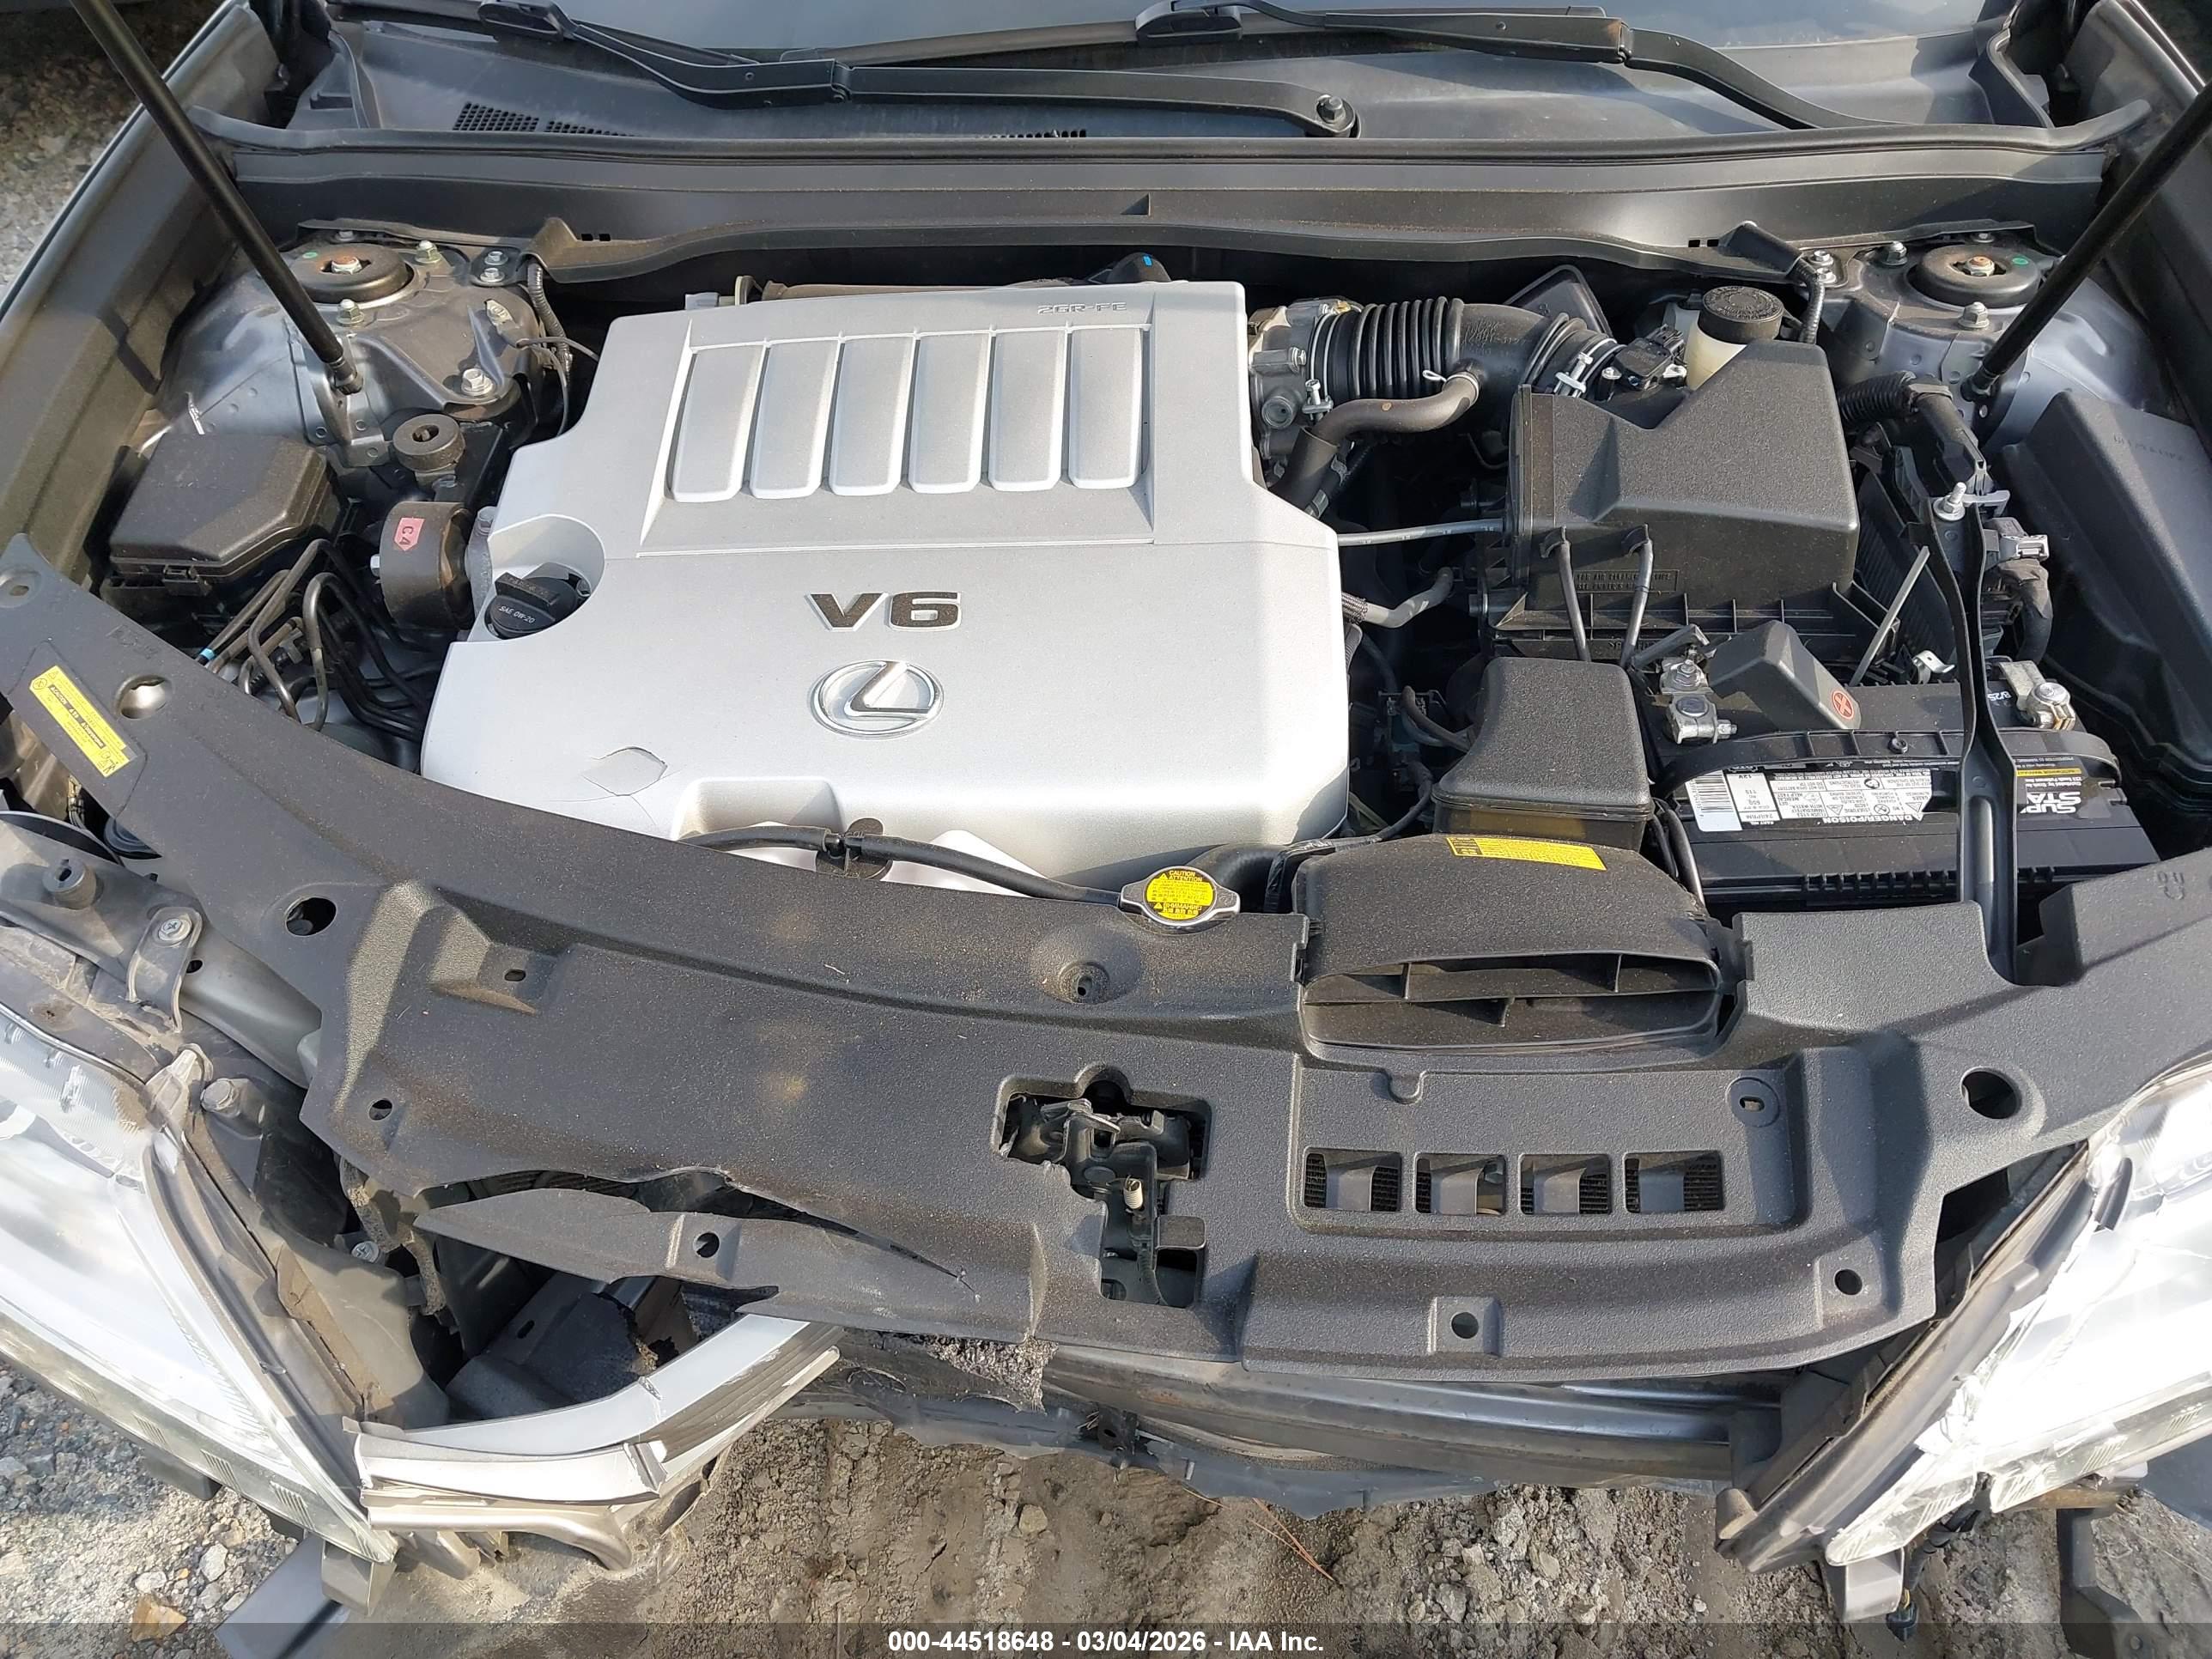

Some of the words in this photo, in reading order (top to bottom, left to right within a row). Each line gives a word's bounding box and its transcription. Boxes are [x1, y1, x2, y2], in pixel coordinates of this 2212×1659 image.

[1037, 301, 1127, 315] 2GR-FE
[398, 526, 414, 545] C4
[498, 605, 514, 616] SAE
[514, 610, 536, 623] 0W-20
[805, 591, 963, 632] V6
[1822, 815, 1913, 823] DANGER/POISON
